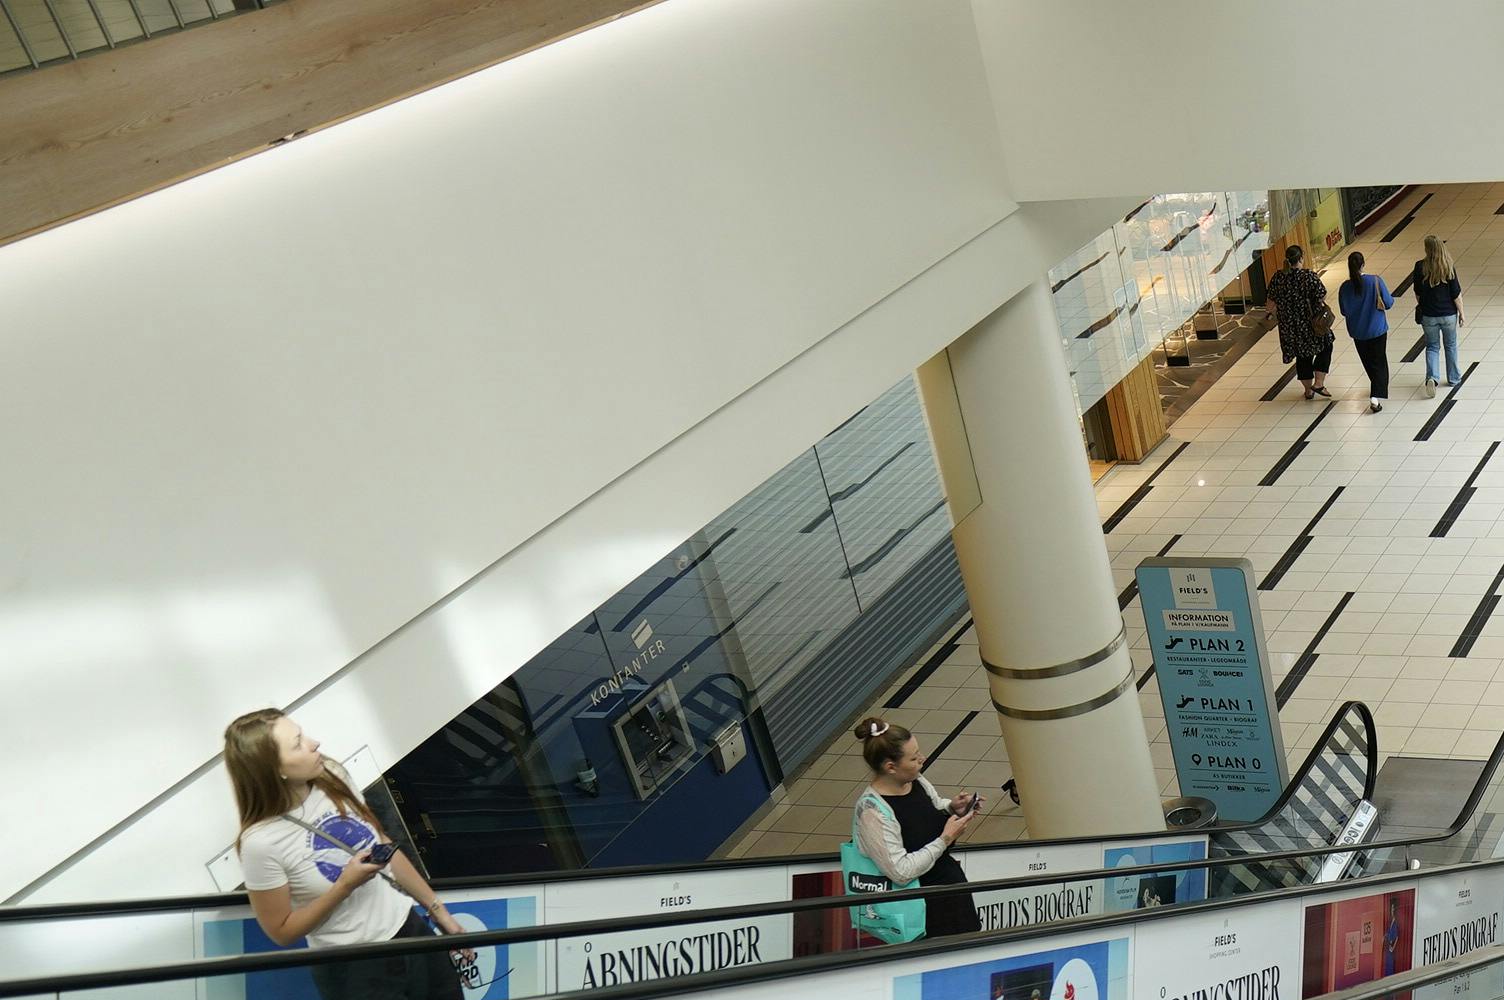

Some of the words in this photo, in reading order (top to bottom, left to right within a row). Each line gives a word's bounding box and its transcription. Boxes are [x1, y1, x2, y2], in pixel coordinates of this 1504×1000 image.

[1179, 587, 1209, 595] FIELD'S
[1168, 613, 1230, 623] INFORMATION
[1190, 638, 1230, 652] PLAN
[1236, 639, 1245, 652] 2
[590, 639, 666, 706] KONTANTER
[1200, 697, 1240, 711] PLAN
[1247, 699, 1253, 711] 1
[1206, 740, 1238, 748] LINDEX
[1207, 756, 1246, 769] PLAN
[1252, 758, 1261, 770] 0
[1028, 862, 1047, 871] FIELD'S
[852, 876, 888, 892] Normal
[660, 895, 692, 907] FIELD'S
[977, 897, 1030, 932] FIELD'S
[1034, 885, 1094, 925] BIOGRAF
[1215, 933, 1237, 947] FIELD'S
[1423, 926, 1458, 966] FIELD'S
[1460, 912, 1499, 956] BIOGRAF
[582, 925, 763, 990] ÅBNINGSTIDER
